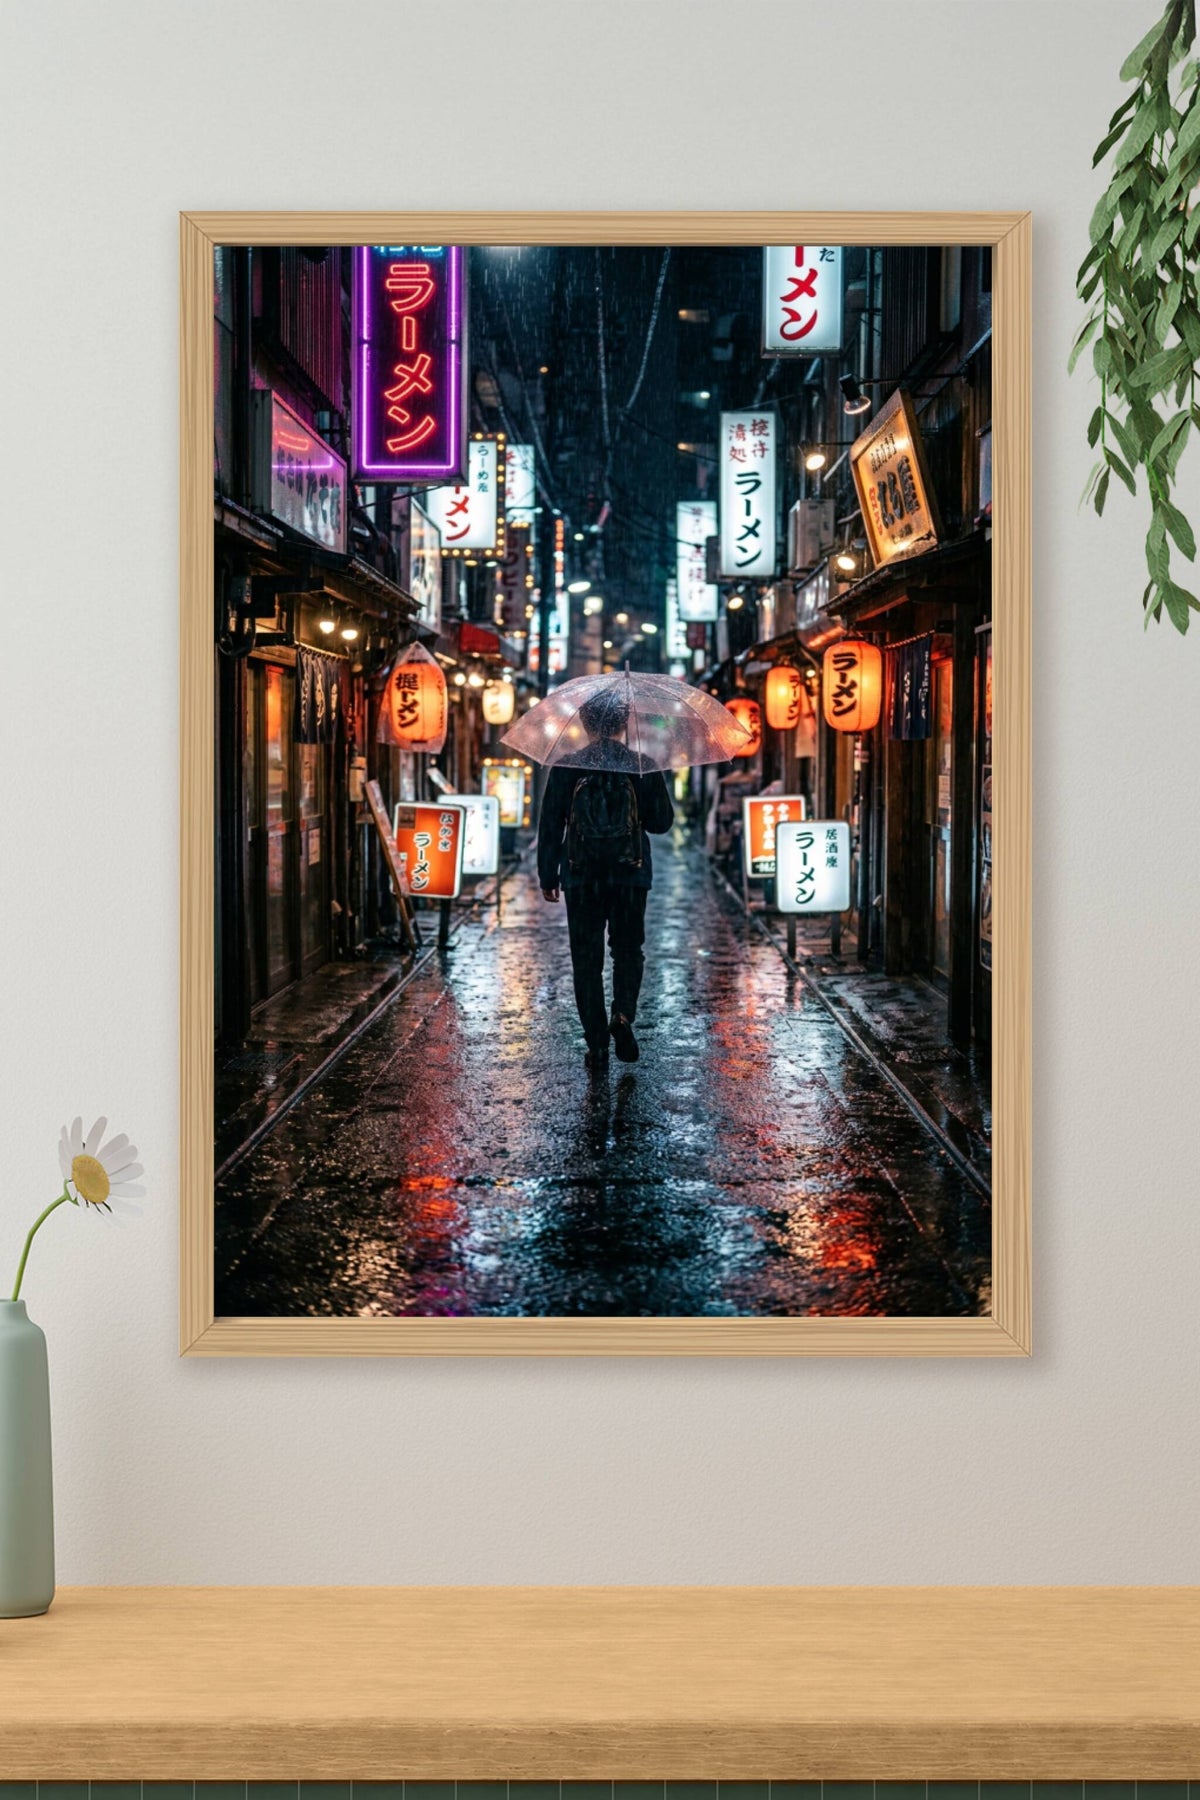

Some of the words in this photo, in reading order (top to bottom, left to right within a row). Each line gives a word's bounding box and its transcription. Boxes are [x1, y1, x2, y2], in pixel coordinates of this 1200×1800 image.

[819, 248, 835, 262] た
[385, 264, 434, 452] ラーメン
[735, 472, 762, 568] ラーメン
[831, 652, 858, 717] ラーメン
[411, 834, 431, 889] ラーメン
[795, 831, 816, 904] ラーメン
